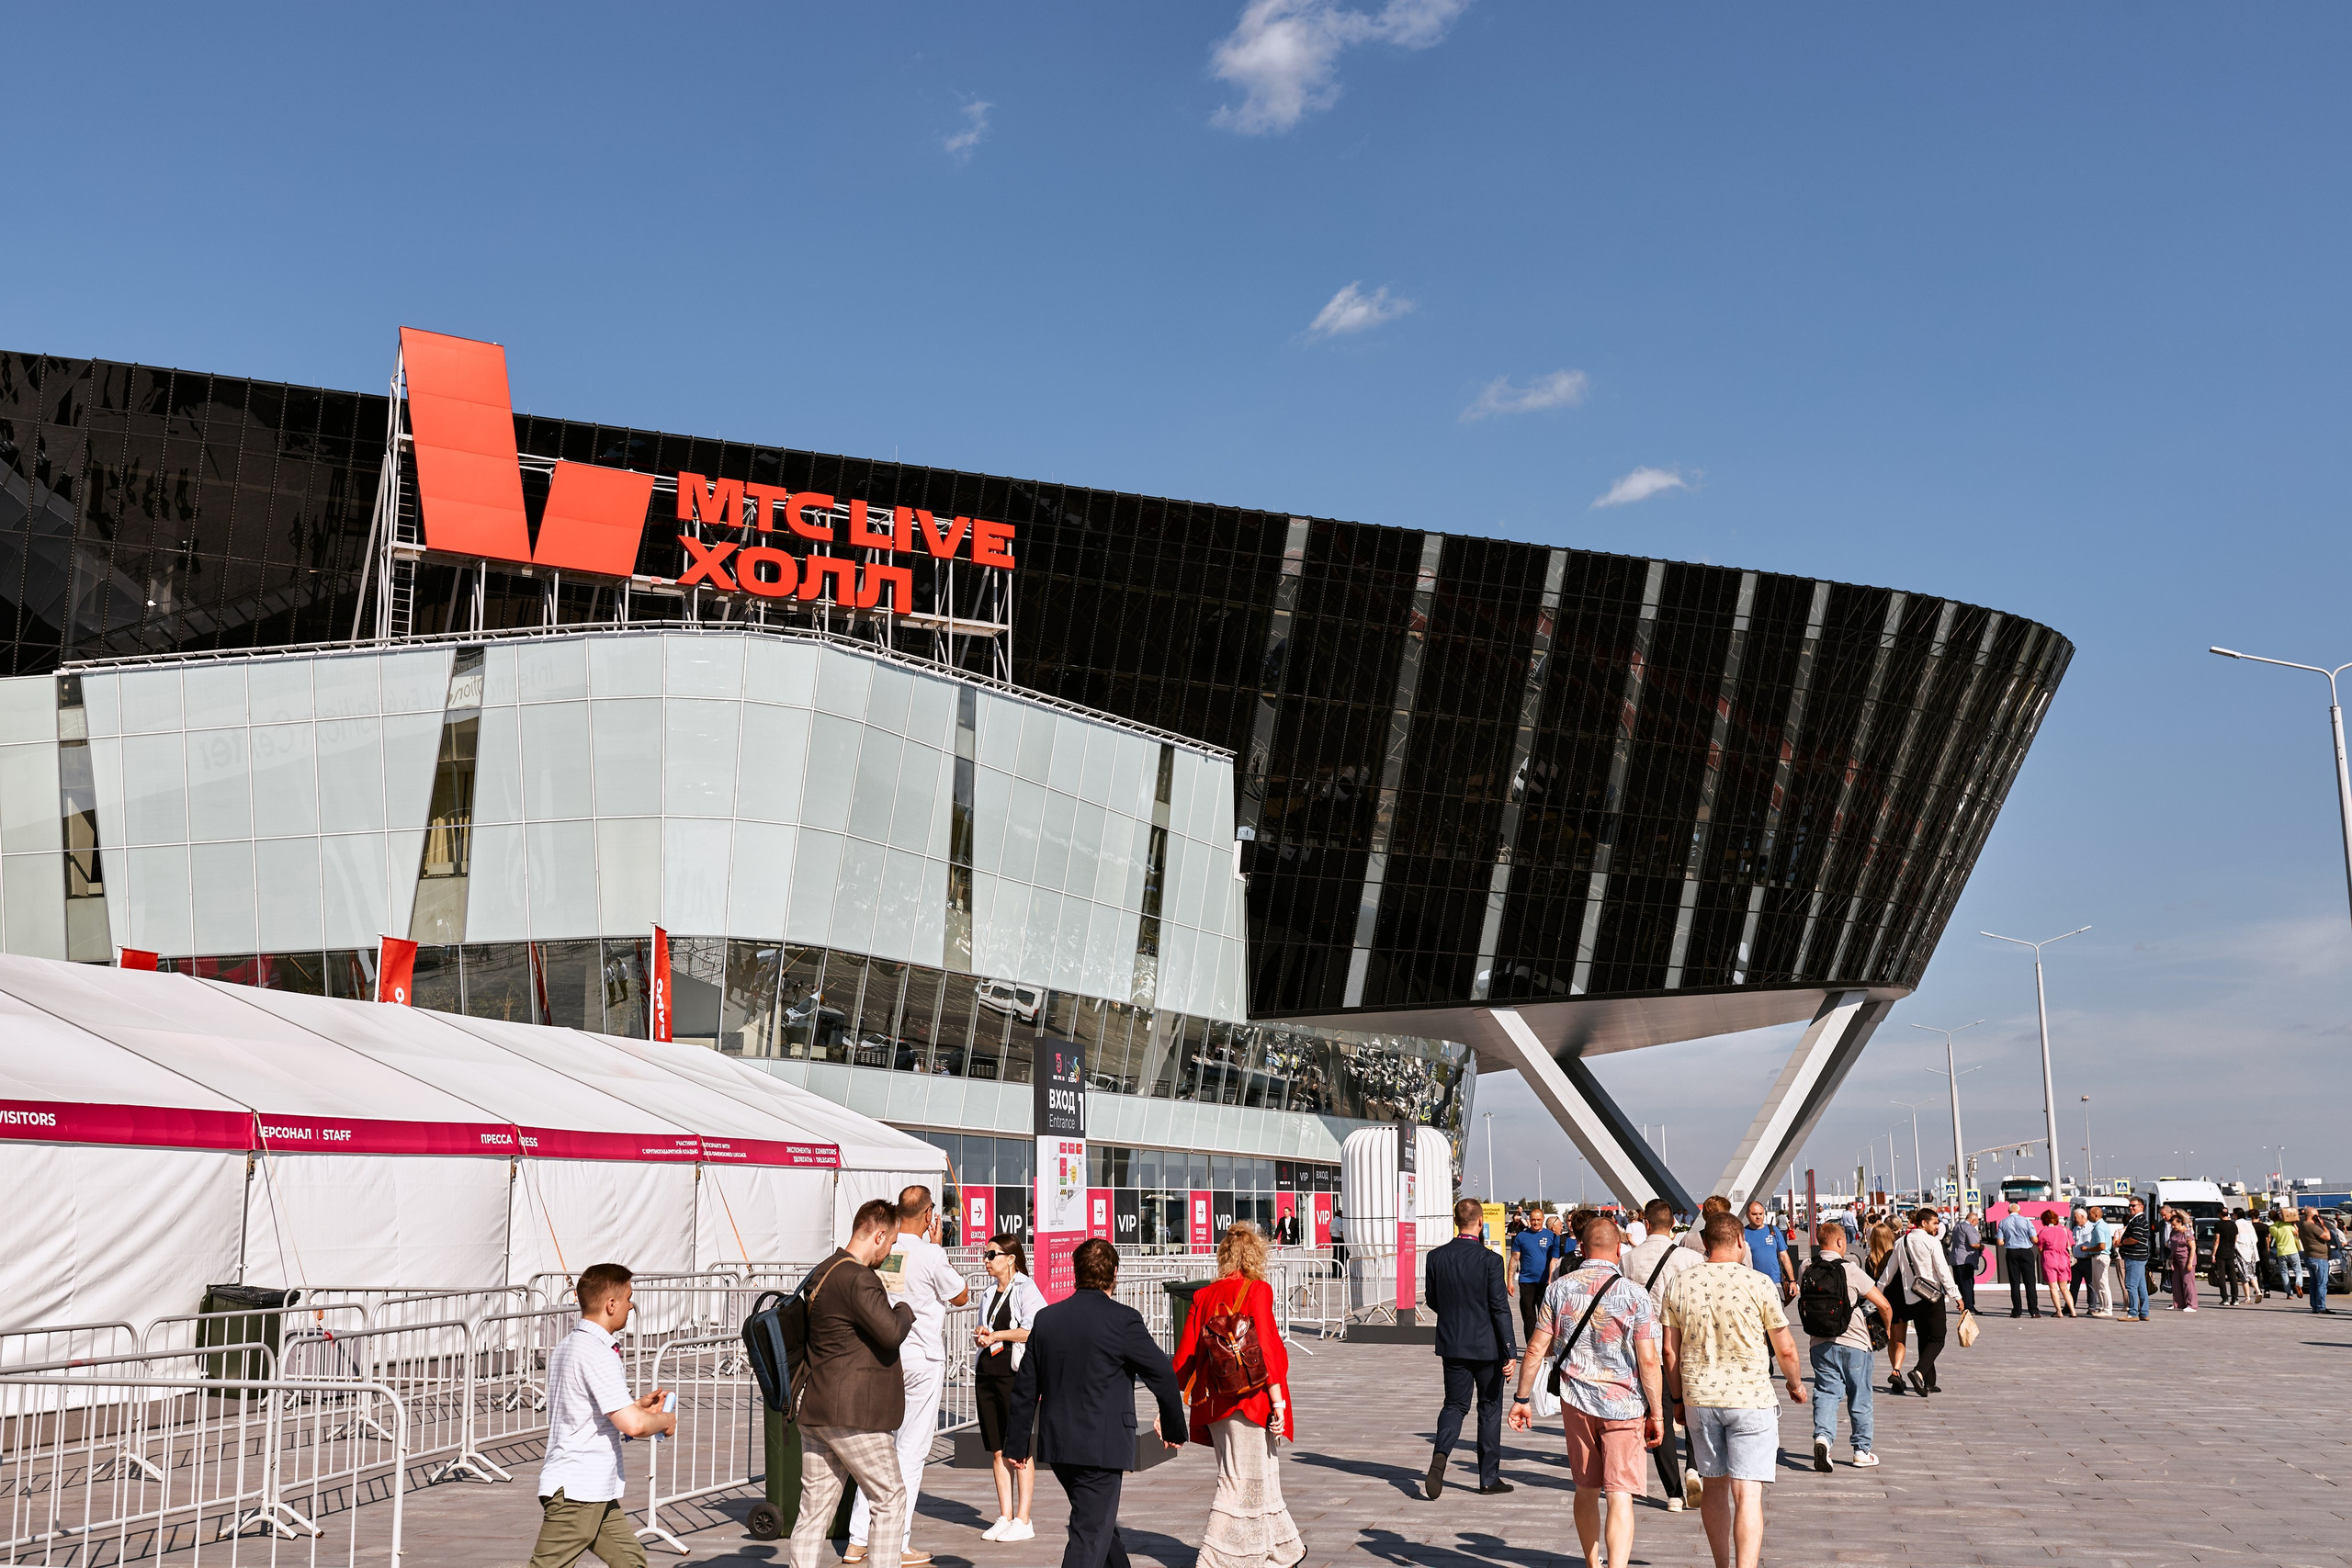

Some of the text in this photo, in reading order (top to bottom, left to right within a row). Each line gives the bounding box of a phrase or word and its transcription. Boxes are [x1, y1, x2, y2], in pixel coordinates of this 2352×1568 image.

[676, 471, 1015, 570] МТС LIVE
[676, 535, 912, 615] ХОЛЛ
[1049, 1088, 1084, 1131] ВХОД 1
[1049, 1113, 1076, 1130] Entrance
[322, 1128, 352, 1142] STAFF
[481, 1134, 514, 1145] ПРЕССА
[1299, 1171, 1309, 1182] VIP
[1316, 1170, 1329, 1181] ВХОД
[1000, 1214, 1023, 1235] VIP
[1117, 1214, 1137, 1233] VIP
[1215, 1213, 1232, 1231] VIP
[1316, 1210, 1330, 1225] VIP
[970, 1230, 987, 1240] ВХОД
